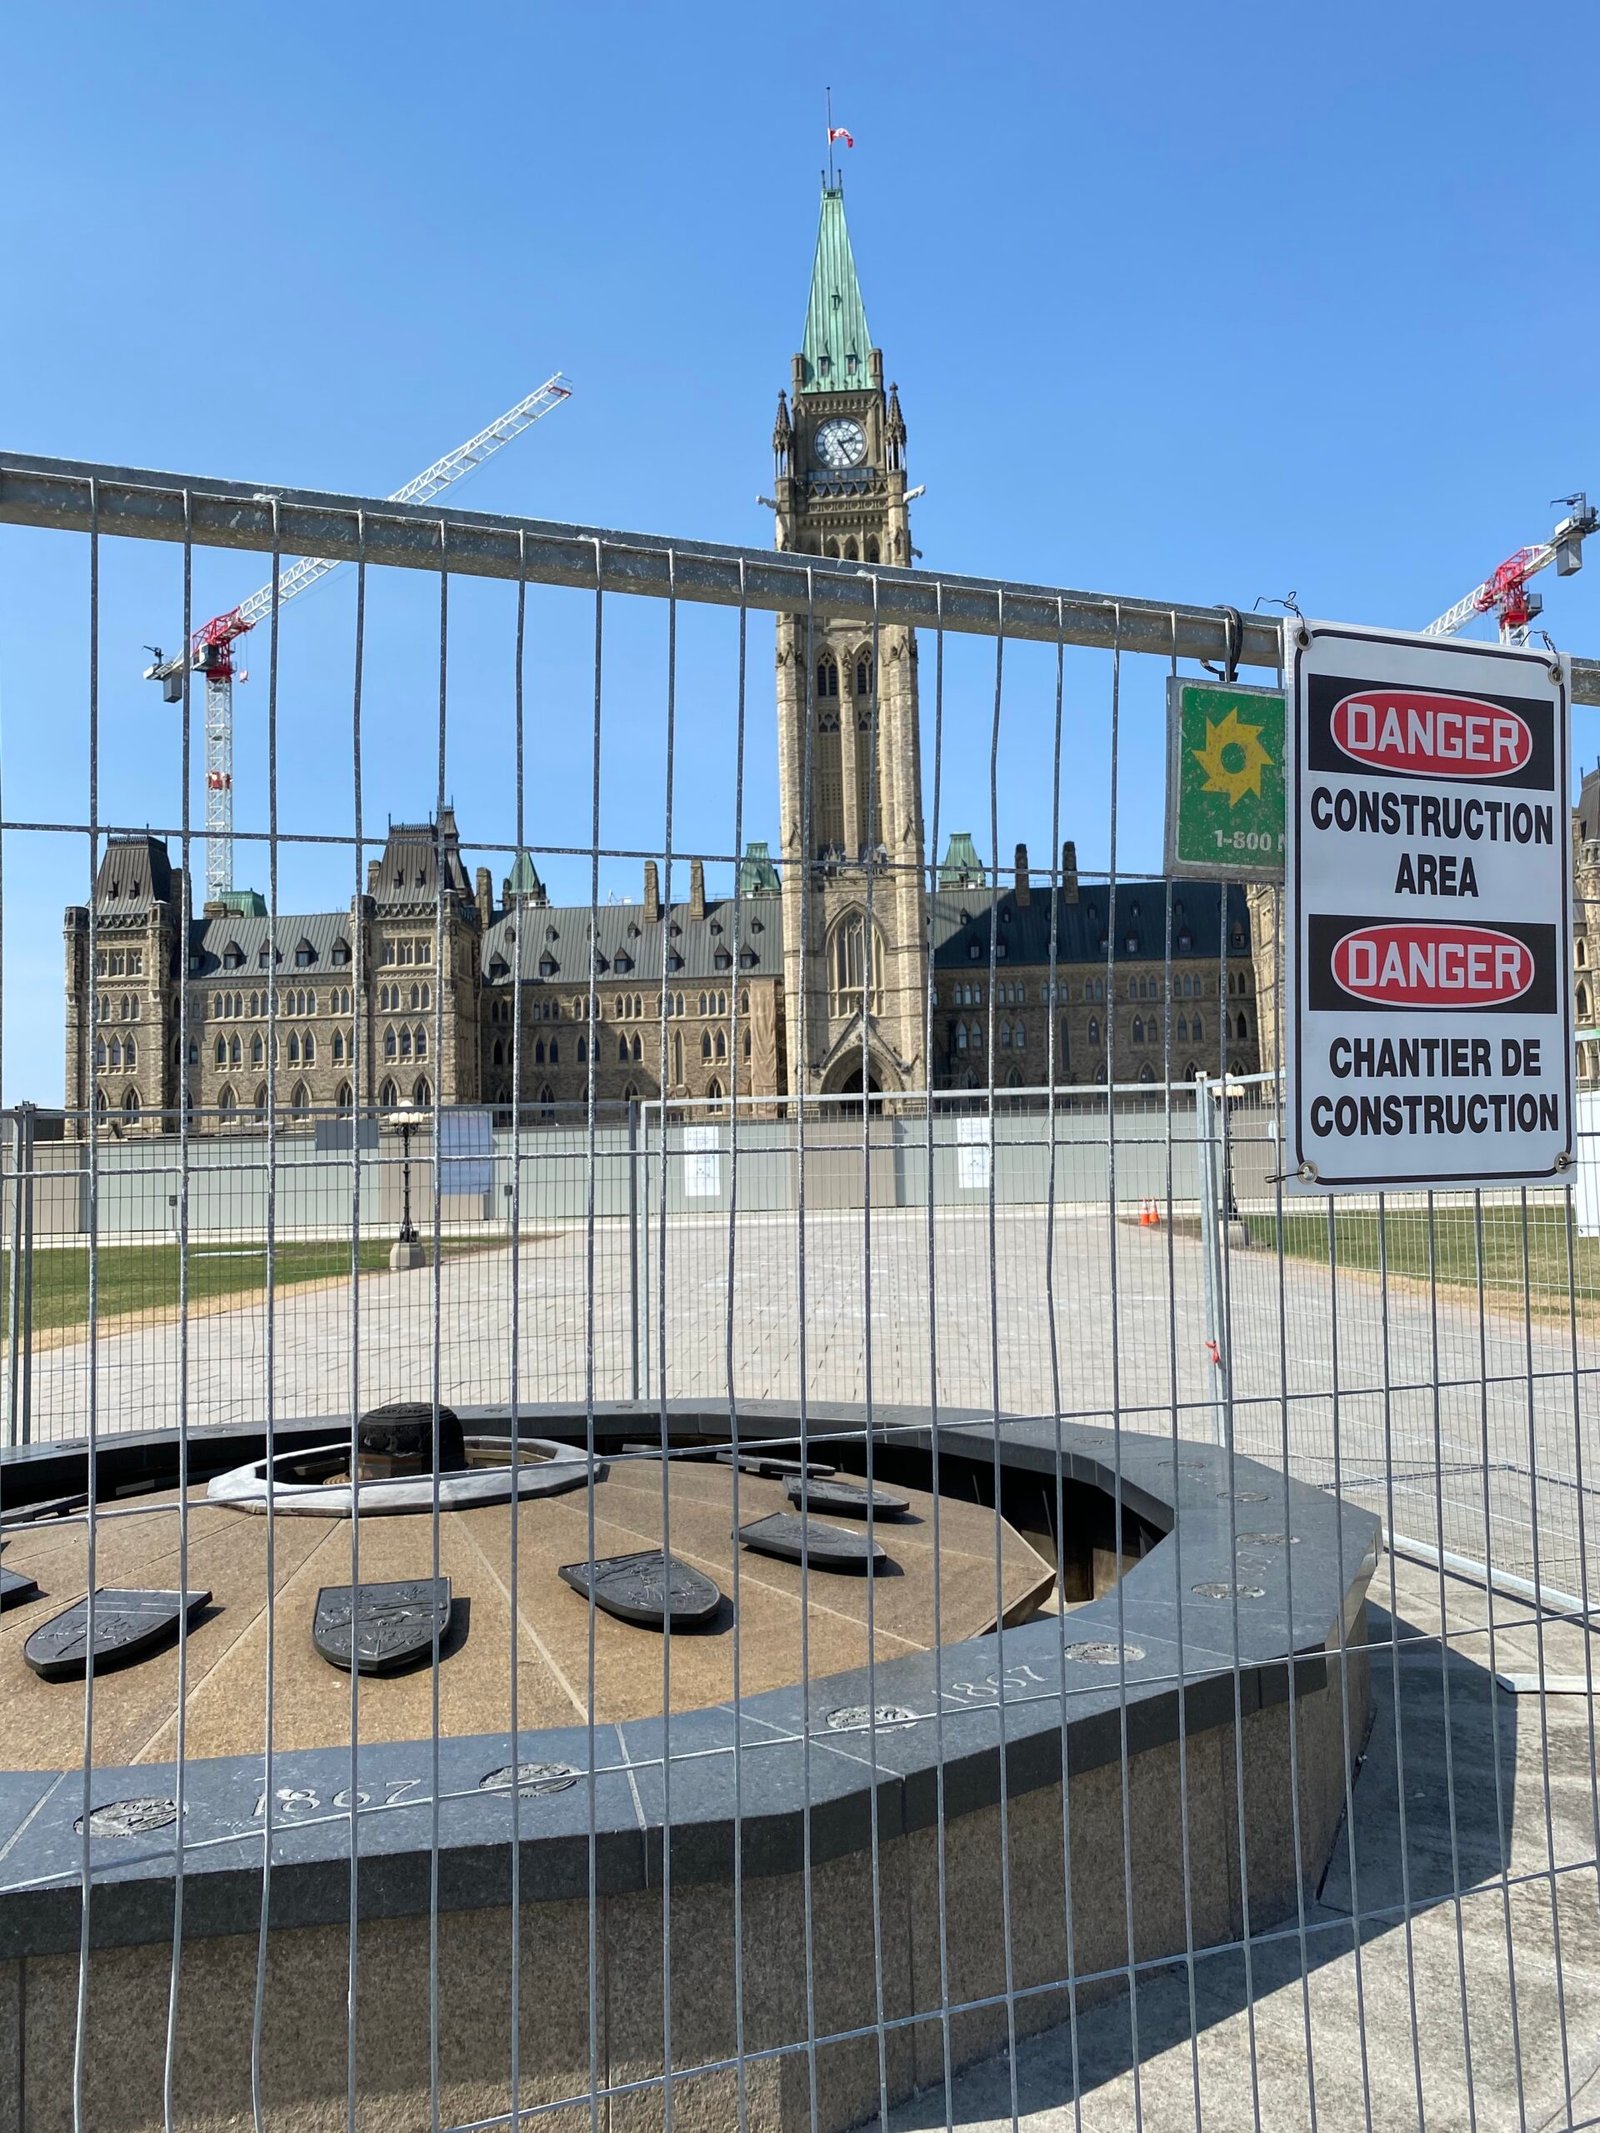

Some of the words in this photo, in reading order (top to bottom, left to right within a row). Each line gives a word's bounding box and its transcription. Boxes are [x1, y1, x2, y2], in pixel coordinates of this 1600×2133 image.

[1347, 702, 1519, 764] DANGER
[1311, 786, 1553, 845] CONSTRUCTION
[1213, 829, 1272, 852] 1-800
[1394, 853, 1479, 898] AREA
[1348, 940, 1522, 990] DANGER
[1329, 1037, 1492, 1079] CHANTIER
[1501, 1038, 1541, 1077] DE
[1310, 1093, 1559, 1138] CONSTRUCTION
[931, 1665, 1049, 1704] 1867
[252, 1778, 421, 1816] 1867
